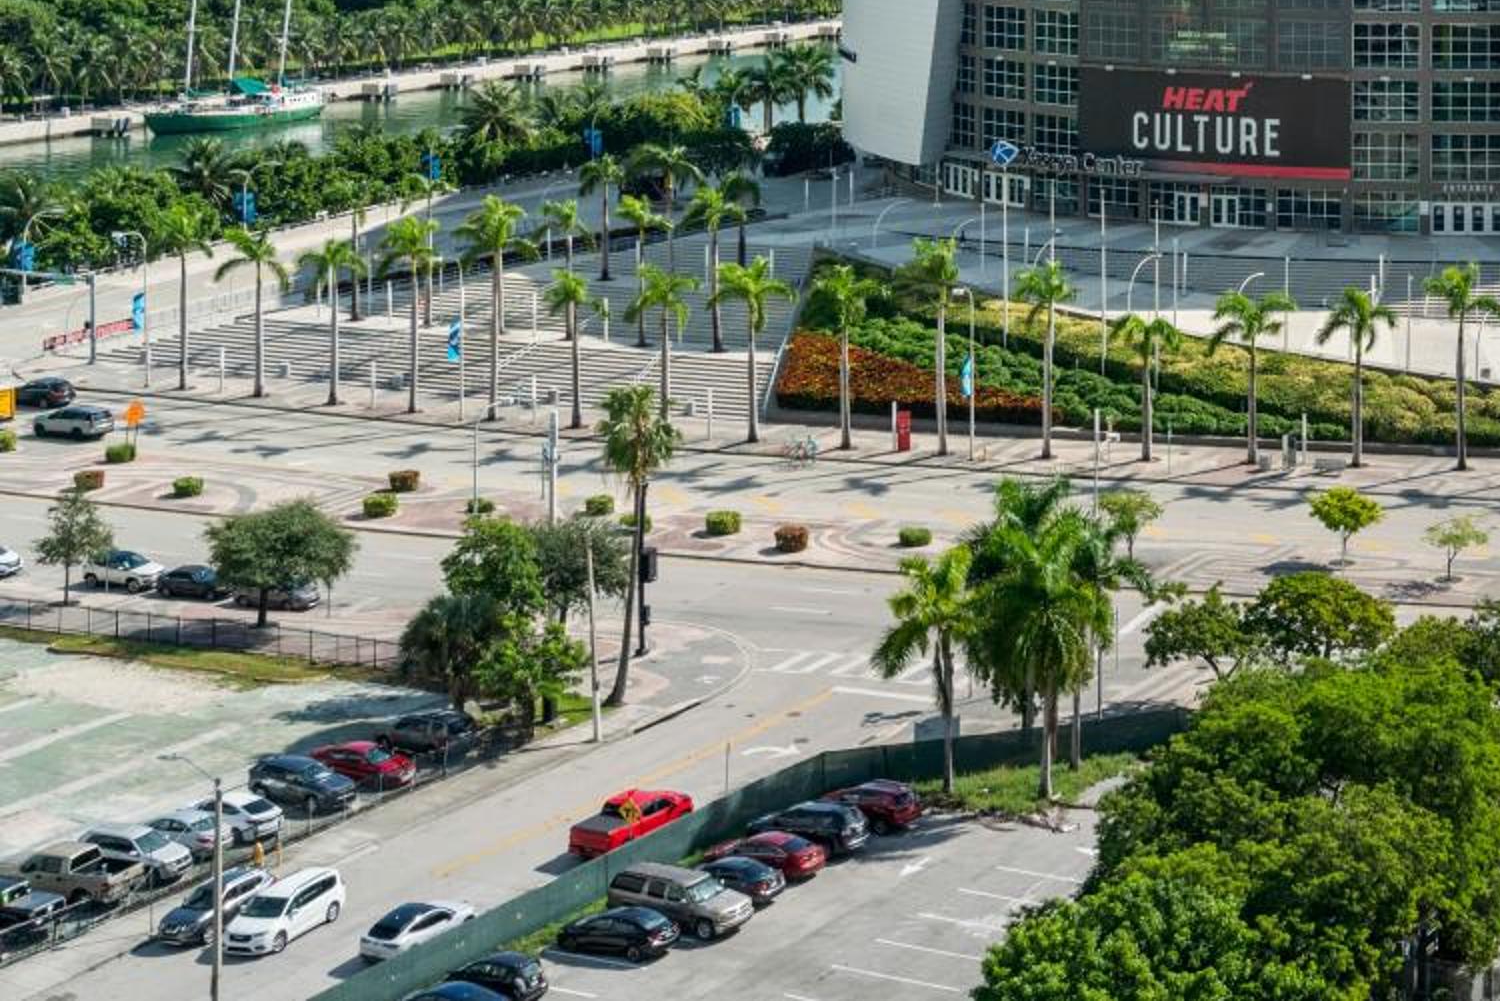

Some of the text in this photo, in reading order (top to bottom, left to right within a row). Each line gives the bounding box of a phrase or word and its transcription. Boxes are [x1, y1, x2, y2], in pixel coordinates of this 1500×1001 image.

[1163, 82, 1252, 112] HEAT
[1133, 111, 1281, 157] CULTURE
[1083, 152, 1144, 176] Center
